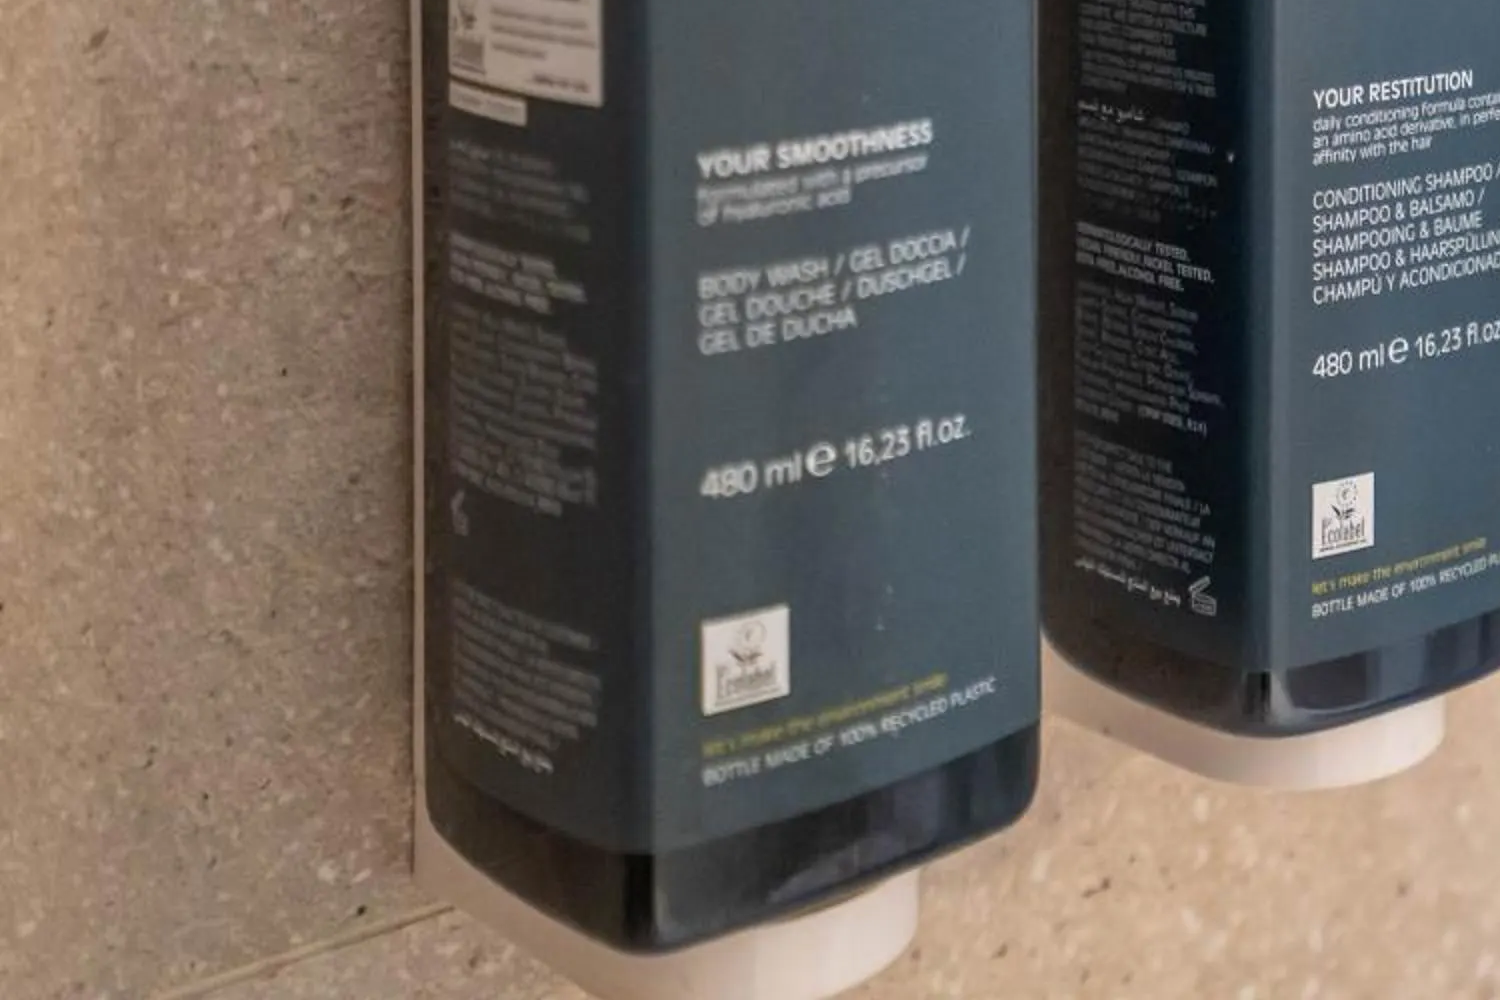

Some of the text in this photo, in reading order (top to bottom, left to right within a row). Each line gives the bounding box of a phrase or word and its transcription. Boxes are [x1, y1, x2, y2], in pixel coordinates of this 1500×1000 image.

[1313, 69, 1474, 109] YOUR RESTITUTION
[1313, 114, 1342, 133] daily
[1345, 103, 1419, 130] conditioning
[1421, 97, 1466, 117] formula
[1313, 134, 1329, 149] an
[1332, 128, 1371, 148] amino
[1373, 122, 1398, 141] acid
[1460, 111, 1471, 126] in
[697, 144, 773, 179] YOUR
[776, 117, 933, 169] SMOOTHNESS
[1313, 135, 1433, 167] affinity with the hair
[1313, 175, 1423, 210] CONDITIONING
[1425, 162, 1494, 192] SHAMPOO
[1313, 205, 1391, 234] SHAMPOO
[1395, 201, 1406, 221] &
[1409, 188, 1474, 217] BALSAMO
[1313, 210, 1483, 258] SHAMPOOING & BAUME
[698, 269, 763, 300] BODY
[765, 258, 831, 288] WASH
[849, 245, 884, 273] GEL
[1313, 252, 1391, 281] SHAMPOO
[1395, 249, 1406, 268] &
[1385, 274, 1396, 292] Y
[698, 300, 741, 329] GEL
[745, 283, 837, 320] DOUCHE
[857, 256, 953, 300] DUSCHGEL
[698, 305, 858, 356] GEL DE DUCHA
[1312, 350, 1354, 379] 480
[1358, 343, 1385, 371] ml
[1414, 326, 1463, 360] 16,23
[700, 462, 758, 499] 480
[764, 454, 803, 489] ml
[1312, 598, 1354, 621] BOTTLE
[1357, 586, 1390, 608] MADE
[1392, 580, 1408, 600] OF
[702, 756, 762, 788] BOTTLE
[764, 741, 812, 770] MADE
[813, 734, 836, 756] OF
